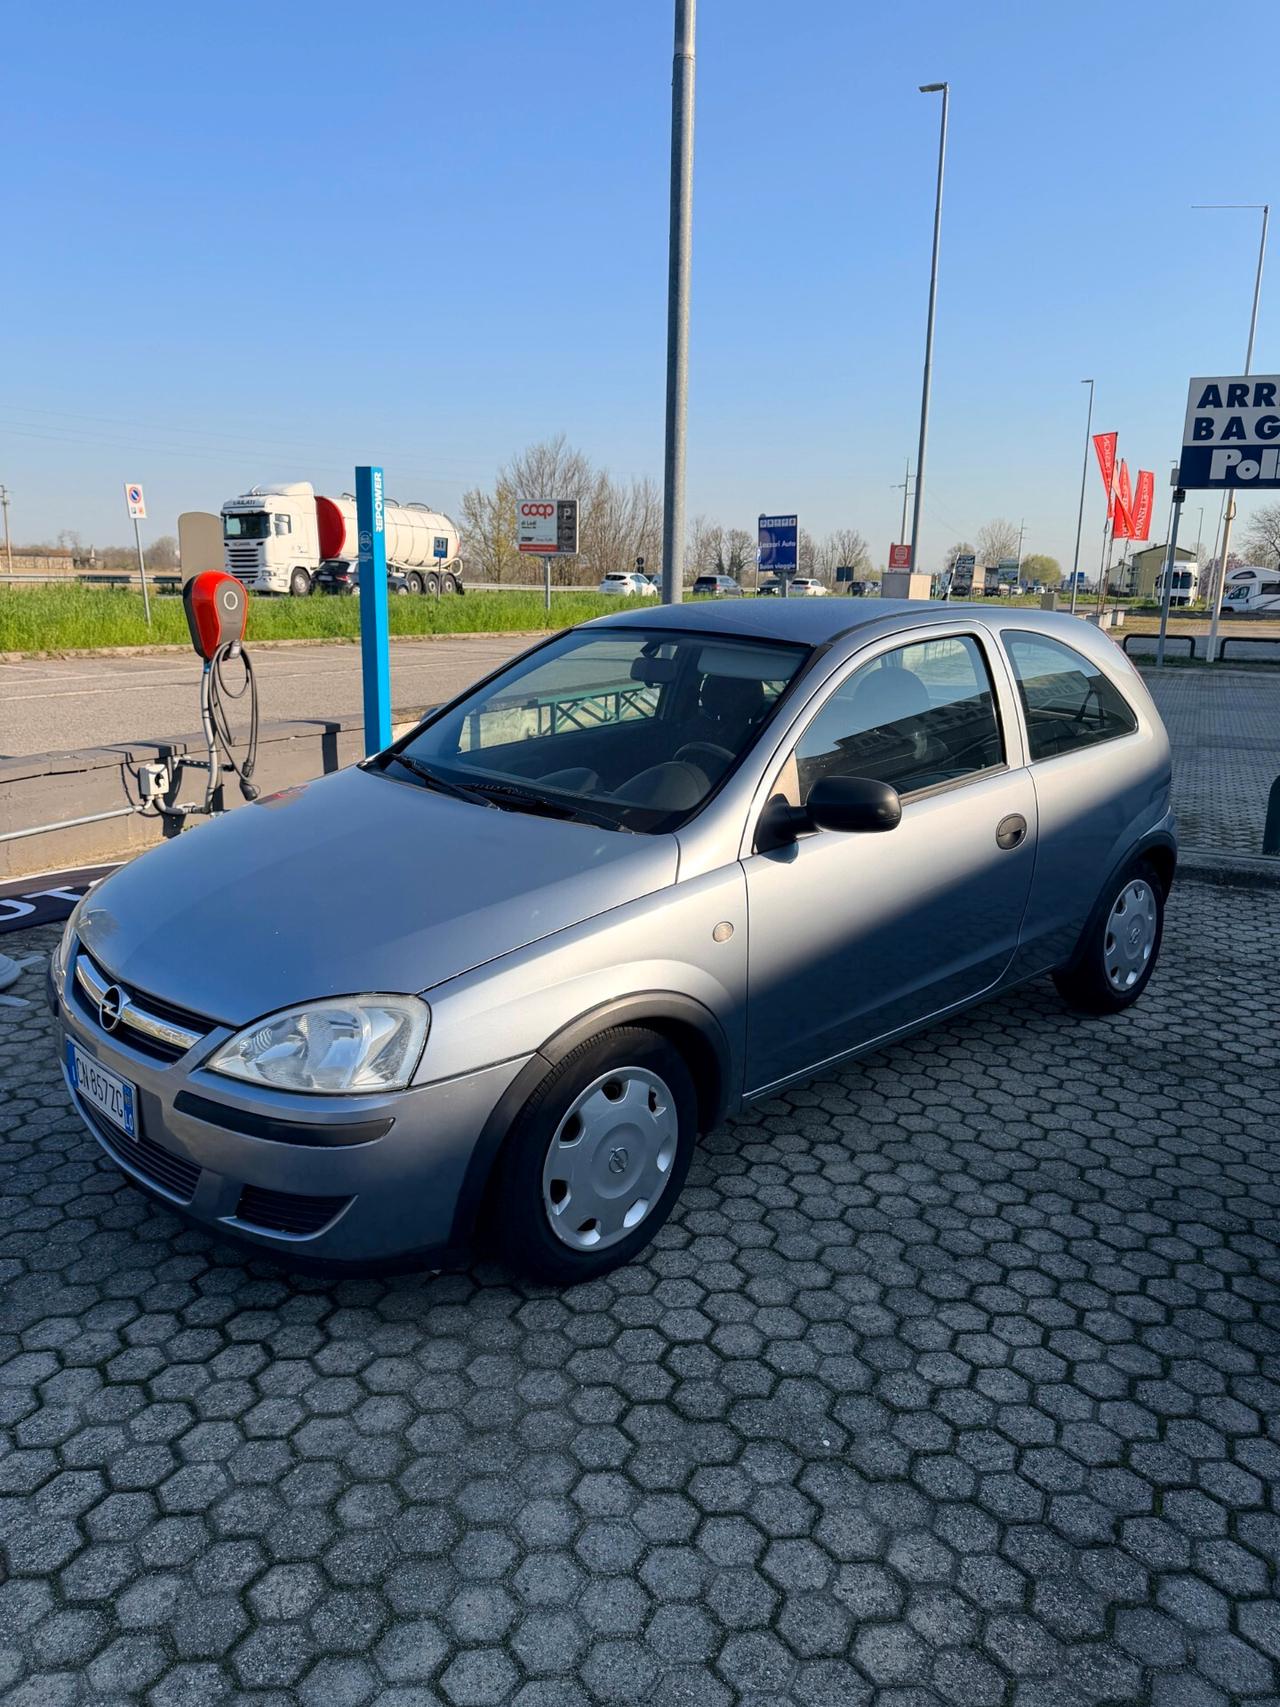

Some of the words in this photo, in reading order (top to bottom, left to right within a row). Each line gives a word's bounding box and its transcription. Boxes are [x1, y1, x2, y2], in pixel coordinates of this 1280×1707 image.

[1196, 383, 1280, 408] ARR
[1192, 415, 1280, 440] BAG
[1209, 449, 1280, 480] Pol
[374, 471, 383, 533] REPOWER
[521, 503, 554, 519] coop
